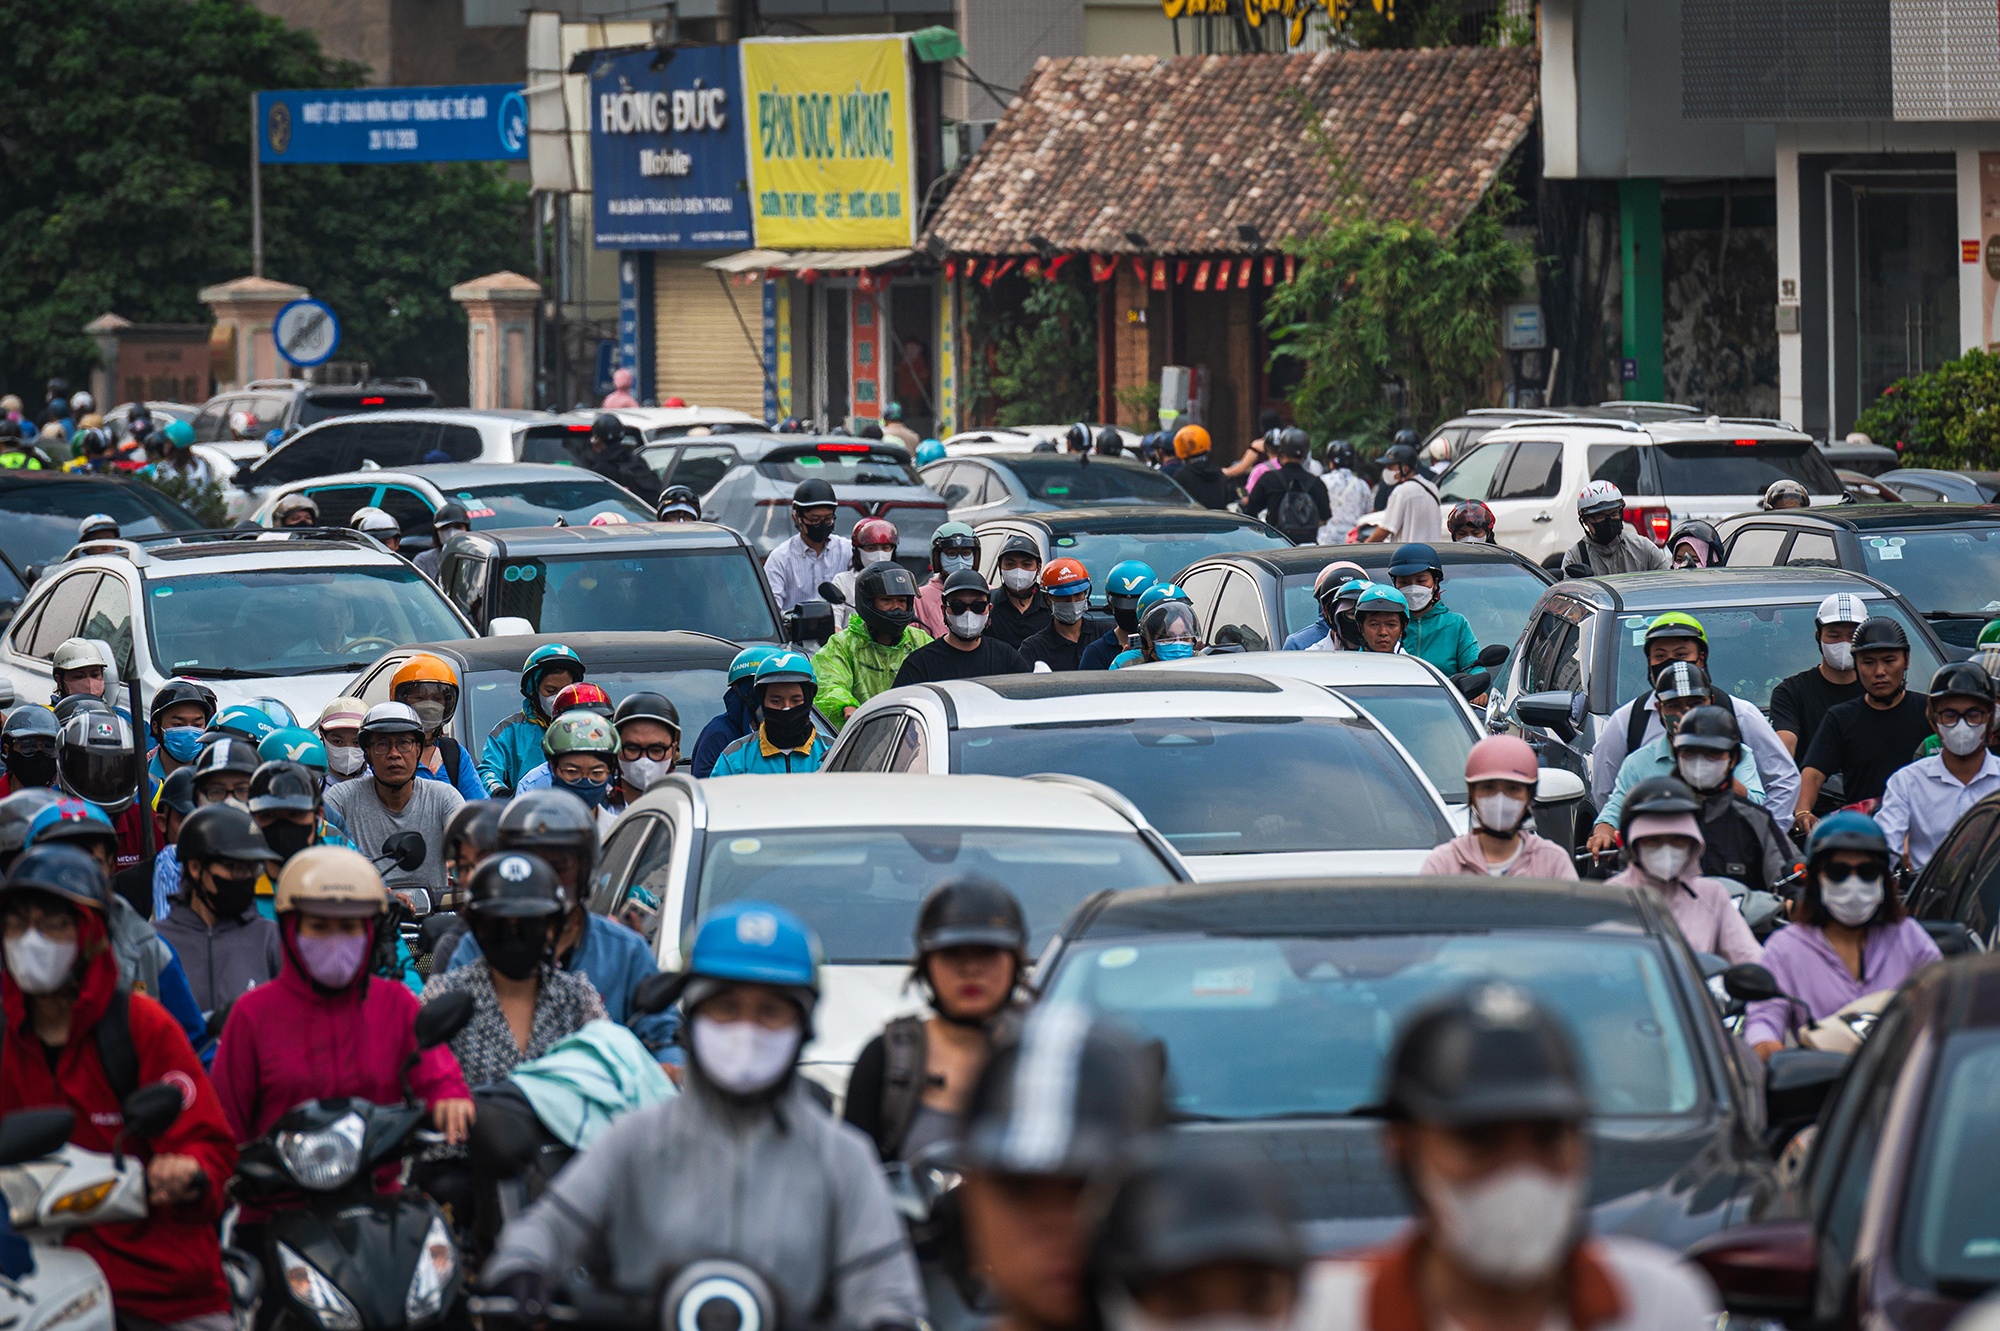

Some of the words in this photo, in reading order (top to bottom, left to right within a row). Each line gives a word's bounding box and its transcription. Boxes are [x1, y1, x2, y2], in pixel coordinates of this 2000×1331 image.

[600, 75, 668, 133] HỒNG
[672, 77, 726, 131] ĐỨC
[732, 662, 750, 672] XANH
